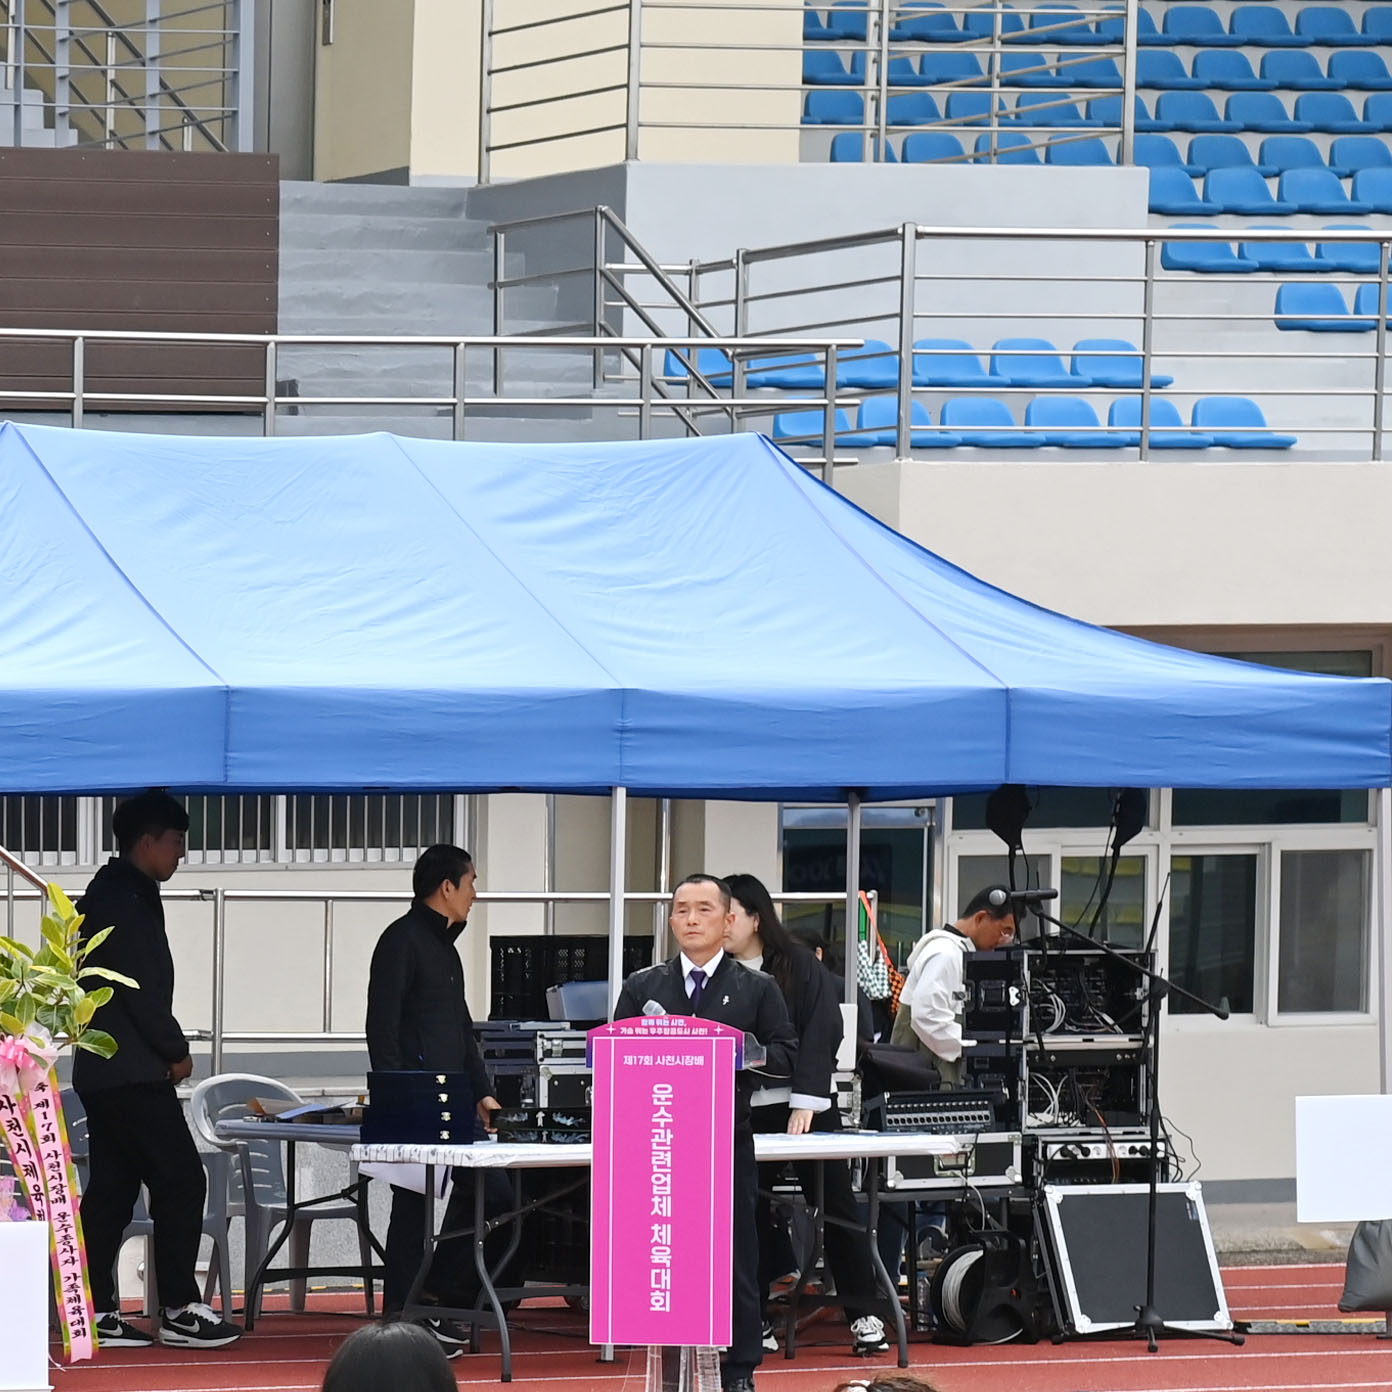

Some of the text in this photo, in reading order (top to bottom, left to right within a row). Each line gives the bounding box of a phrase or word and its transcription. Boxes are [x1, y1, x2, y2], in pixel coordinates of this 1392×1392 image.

[623, 1055, 705, 1066] 제17회 사천시장배
[649, 1083, 674, 1312] 운수관련업체 체육대회
